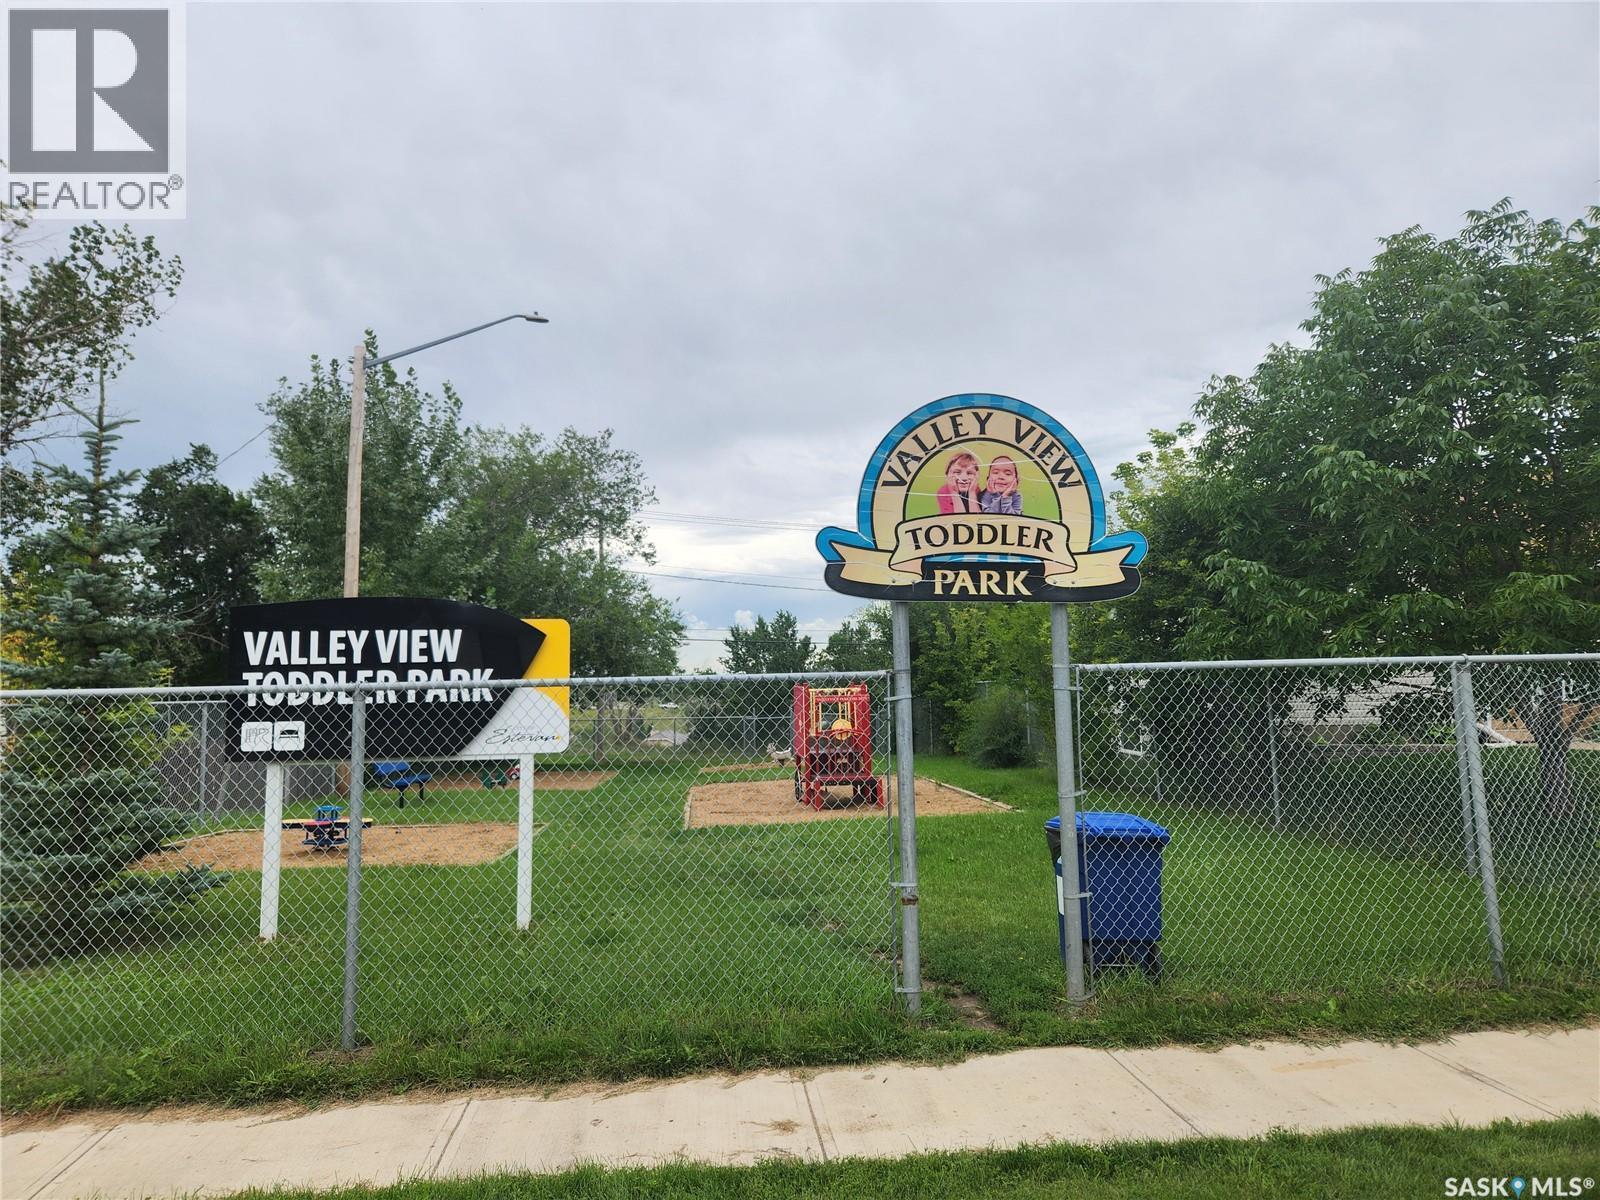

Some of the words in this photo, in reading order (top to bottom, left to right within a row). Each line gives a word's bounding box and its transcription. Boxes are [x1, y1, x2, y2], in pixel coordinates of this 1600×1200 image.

[881, 411, 993, 488] VALLEY
[1014, 417, 1083, 489] VIEW
[904, 523, 1054, 553] TODDLER
[933, 569, 1032, 596] PARK
[243, 630, 369, 666] VALLEY
[374, 629, 463, 663] VIEW
[242, 670, 398, 707] TODDLER
[407, 668, 494, 704] PARK
